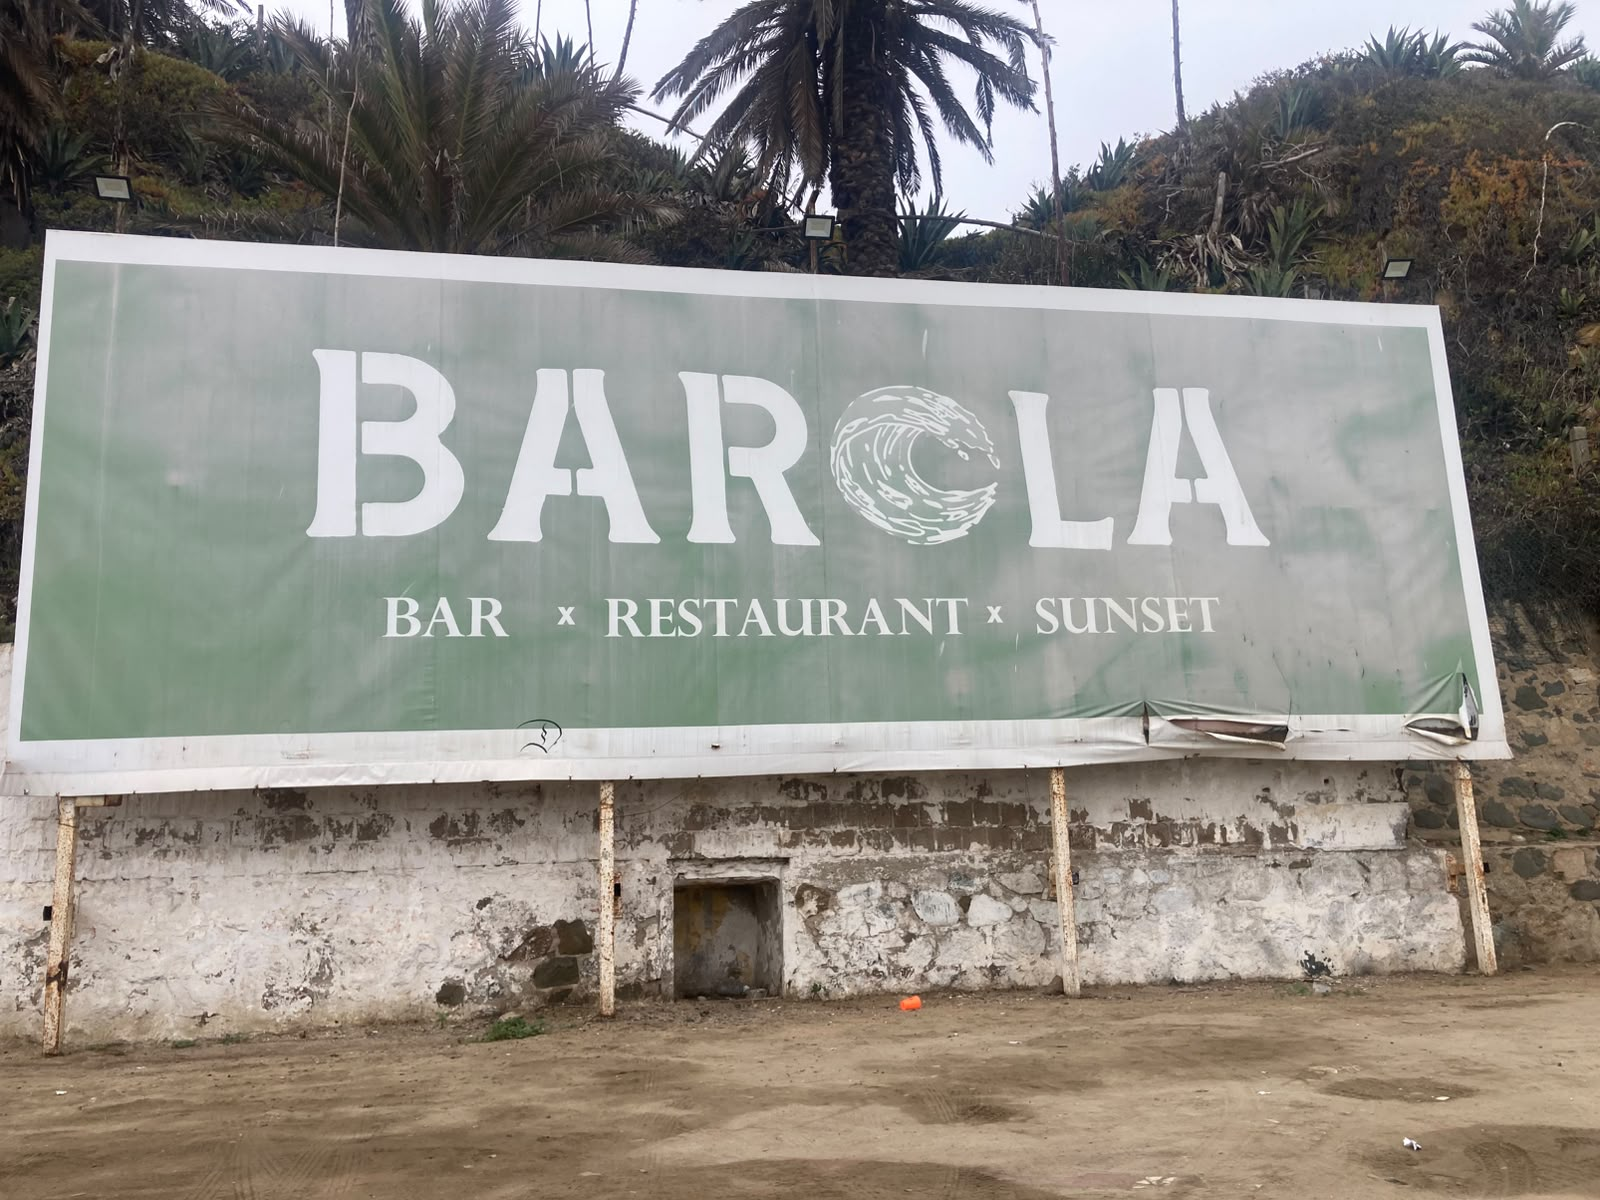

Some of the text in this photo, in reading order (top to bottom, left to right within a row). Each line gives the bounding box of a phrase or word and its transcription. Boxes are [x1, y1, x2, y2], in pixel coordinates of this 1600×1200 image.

[307, 348, 1270, 550] BAROLA
[382, 596, 510, 638] BAR
[605, 597, 969, 638] RESTAURANT
[1035, 596, 1220, 635] SUNSET
